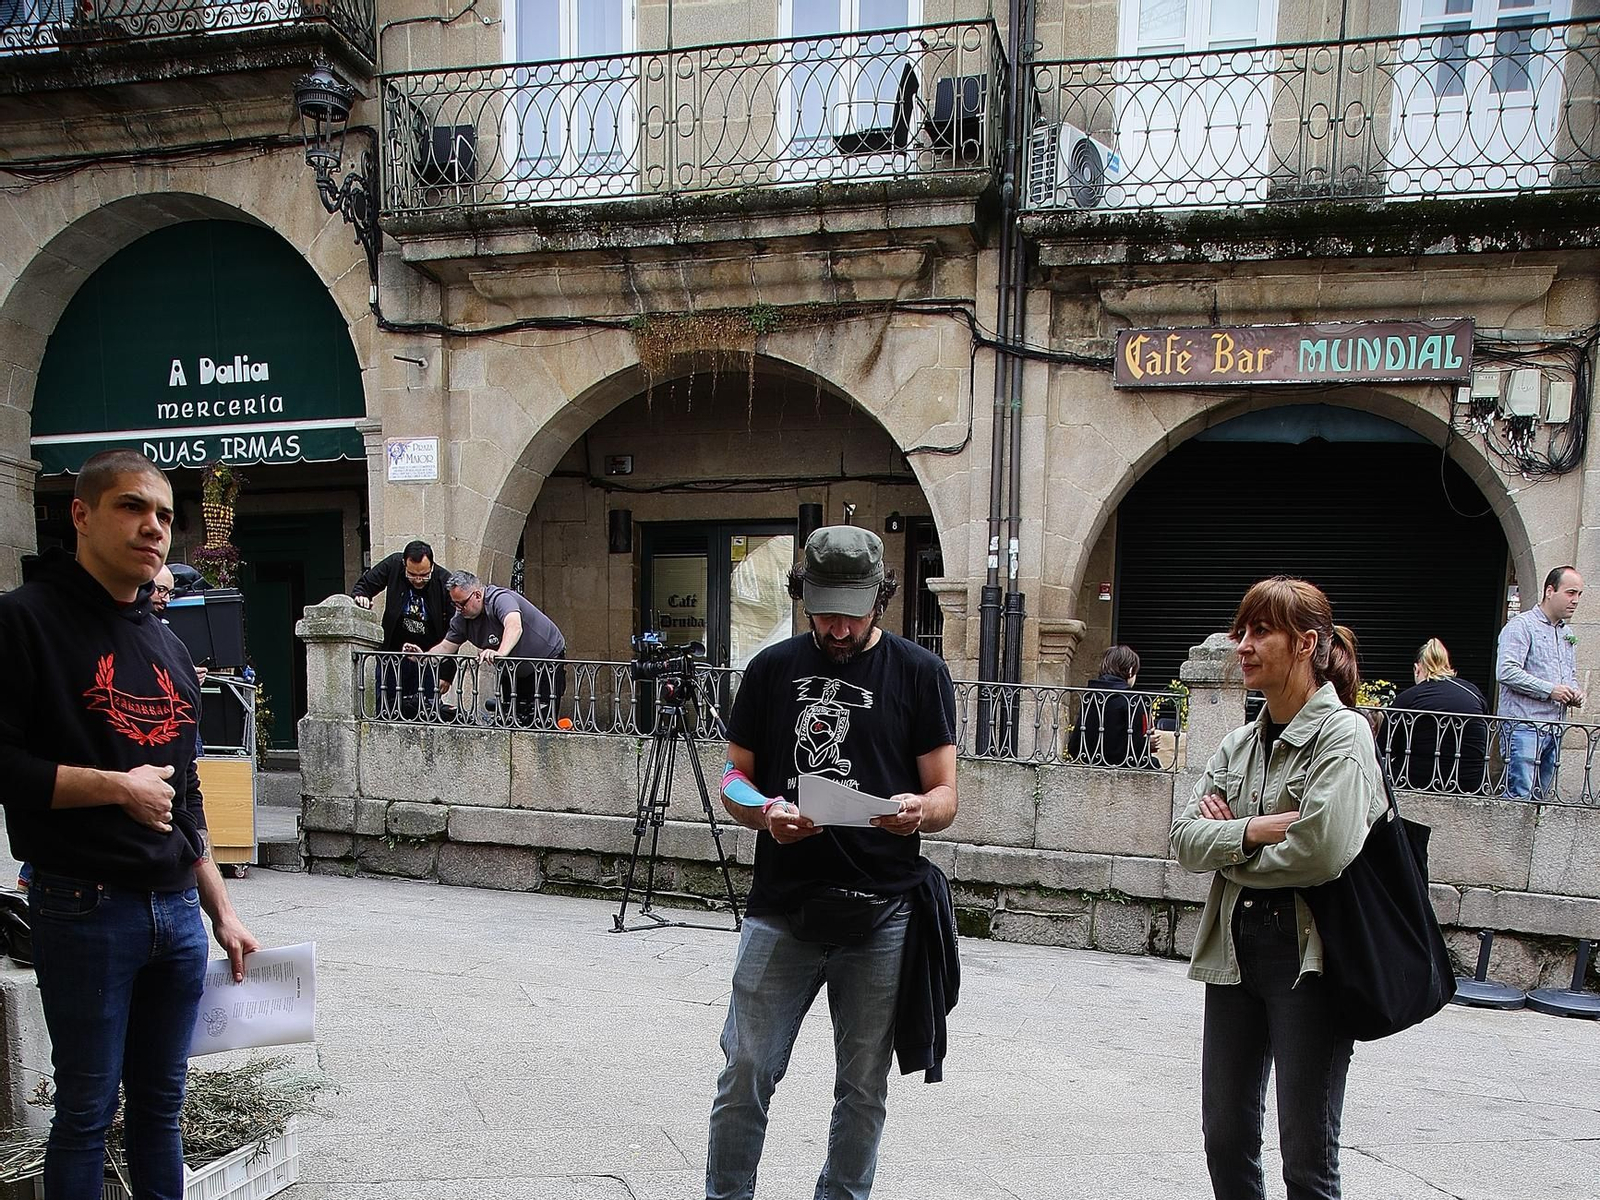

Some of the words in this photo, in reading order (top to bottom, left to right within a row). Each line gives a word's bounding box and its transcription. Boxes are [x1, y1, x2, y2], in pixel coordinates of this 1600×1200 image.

[1125, 332, 1192, 380] Café
[1210, 333, 1273, 375] Bar
[1298, 334, 1463, 373] MUNDIAL
[169, 359, 187, 387] A
[199, 354, 270, 385] Dalia
[143, 439, 207, 463] DUAS
[220, 435, 300, 460] IRMAS
[892, 521, 898, 530] 8
[668, 593, 698, 607] Café
[660, 613, 705, 628] Druida
